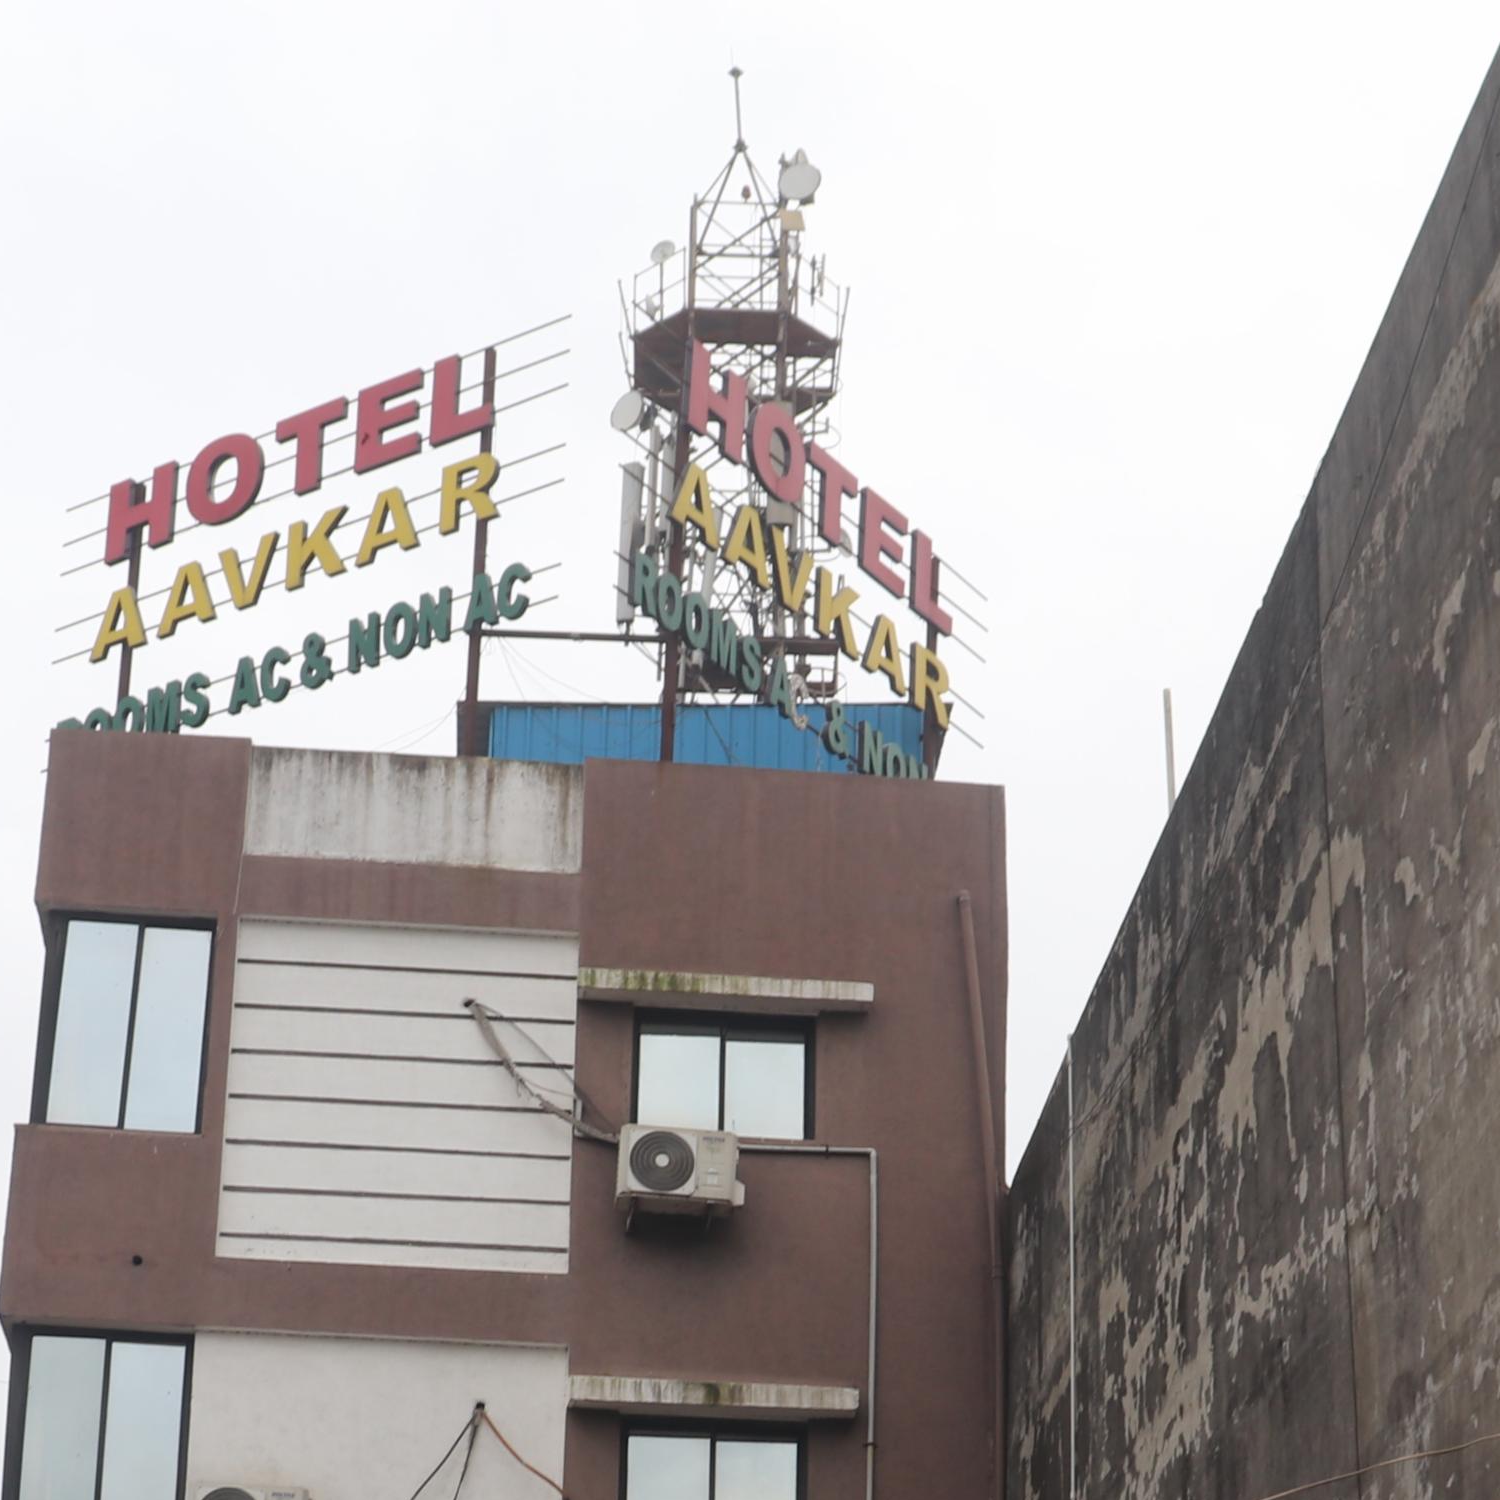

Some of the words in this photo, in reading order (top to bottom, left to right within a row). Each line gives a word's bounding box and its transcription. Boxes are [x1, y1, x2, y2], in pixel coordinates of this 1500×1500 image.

[90, 451, 500, 663] AAVKAR
[103, 355, 495, 566] HOTEL
[685, 340, 953, 637] HOTEL
[227, 646, 292, 716] AC
[300, 633, 332, 690] &
[347, 587, 453, 674] NON
[465, 562, 533, 634] AC
[670, 461, 952, 730] AAVKAR
